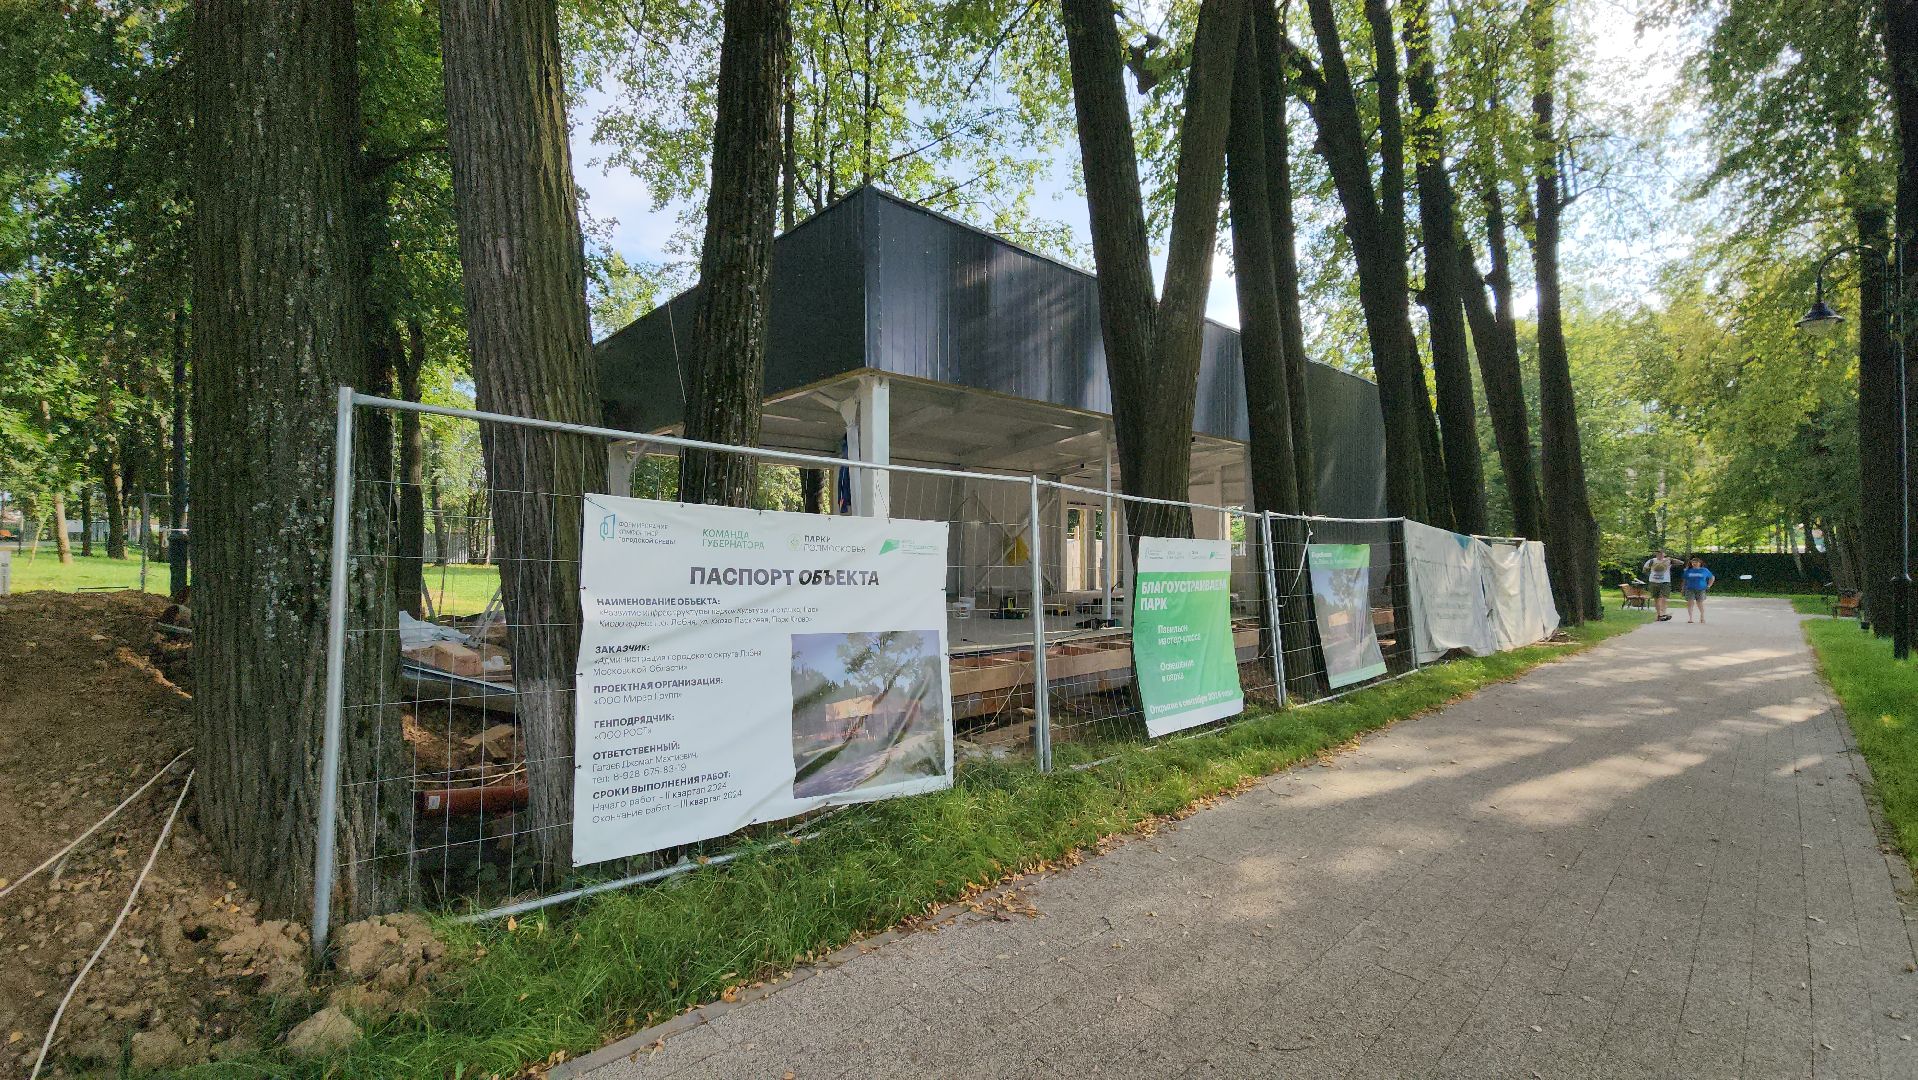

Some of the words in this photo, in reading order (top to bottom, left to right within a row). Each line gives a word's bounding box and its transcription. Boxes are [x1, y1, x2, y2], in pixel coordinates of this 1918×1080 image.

[702, 528, 749, 540] КОМАНДА
[804, 534, 831, 543] ПАРКИ
[702, 538, 765, 550] ГУБЕРНАТОРА
[689, 566, 795, 586] ПАСПОРТ
[798, 569, 880, 586] ОБЪЕКТА
[596, 597, 677, 606] НАИМЕНОВАНИЕ
[677, 597, 721, 606] ОБЪЕКТА:
[1140, 597, 1168, 611] ПАРК
[595, 644, 650, 654] ЗАКАЗЧИК:
[593, 681, 654, 694] ПРОЕКТНАЯ
[654, 677, 723, 689] ОРГАНИЗАЦИЯ:
[593, 713, 675, 729] ГЕНПОДРЯДЧИК:
[592, 740, 681, 761] ОТВЕТСТВЕННЫЙ:
[592, 774, 610, 785] тел:
[592, 786, 630, 800] СРОКИ
[631, 775, 700, 794] ВЫПОЛНЕНИЯ
[700, 770, 732, 783] РАБОТ:
